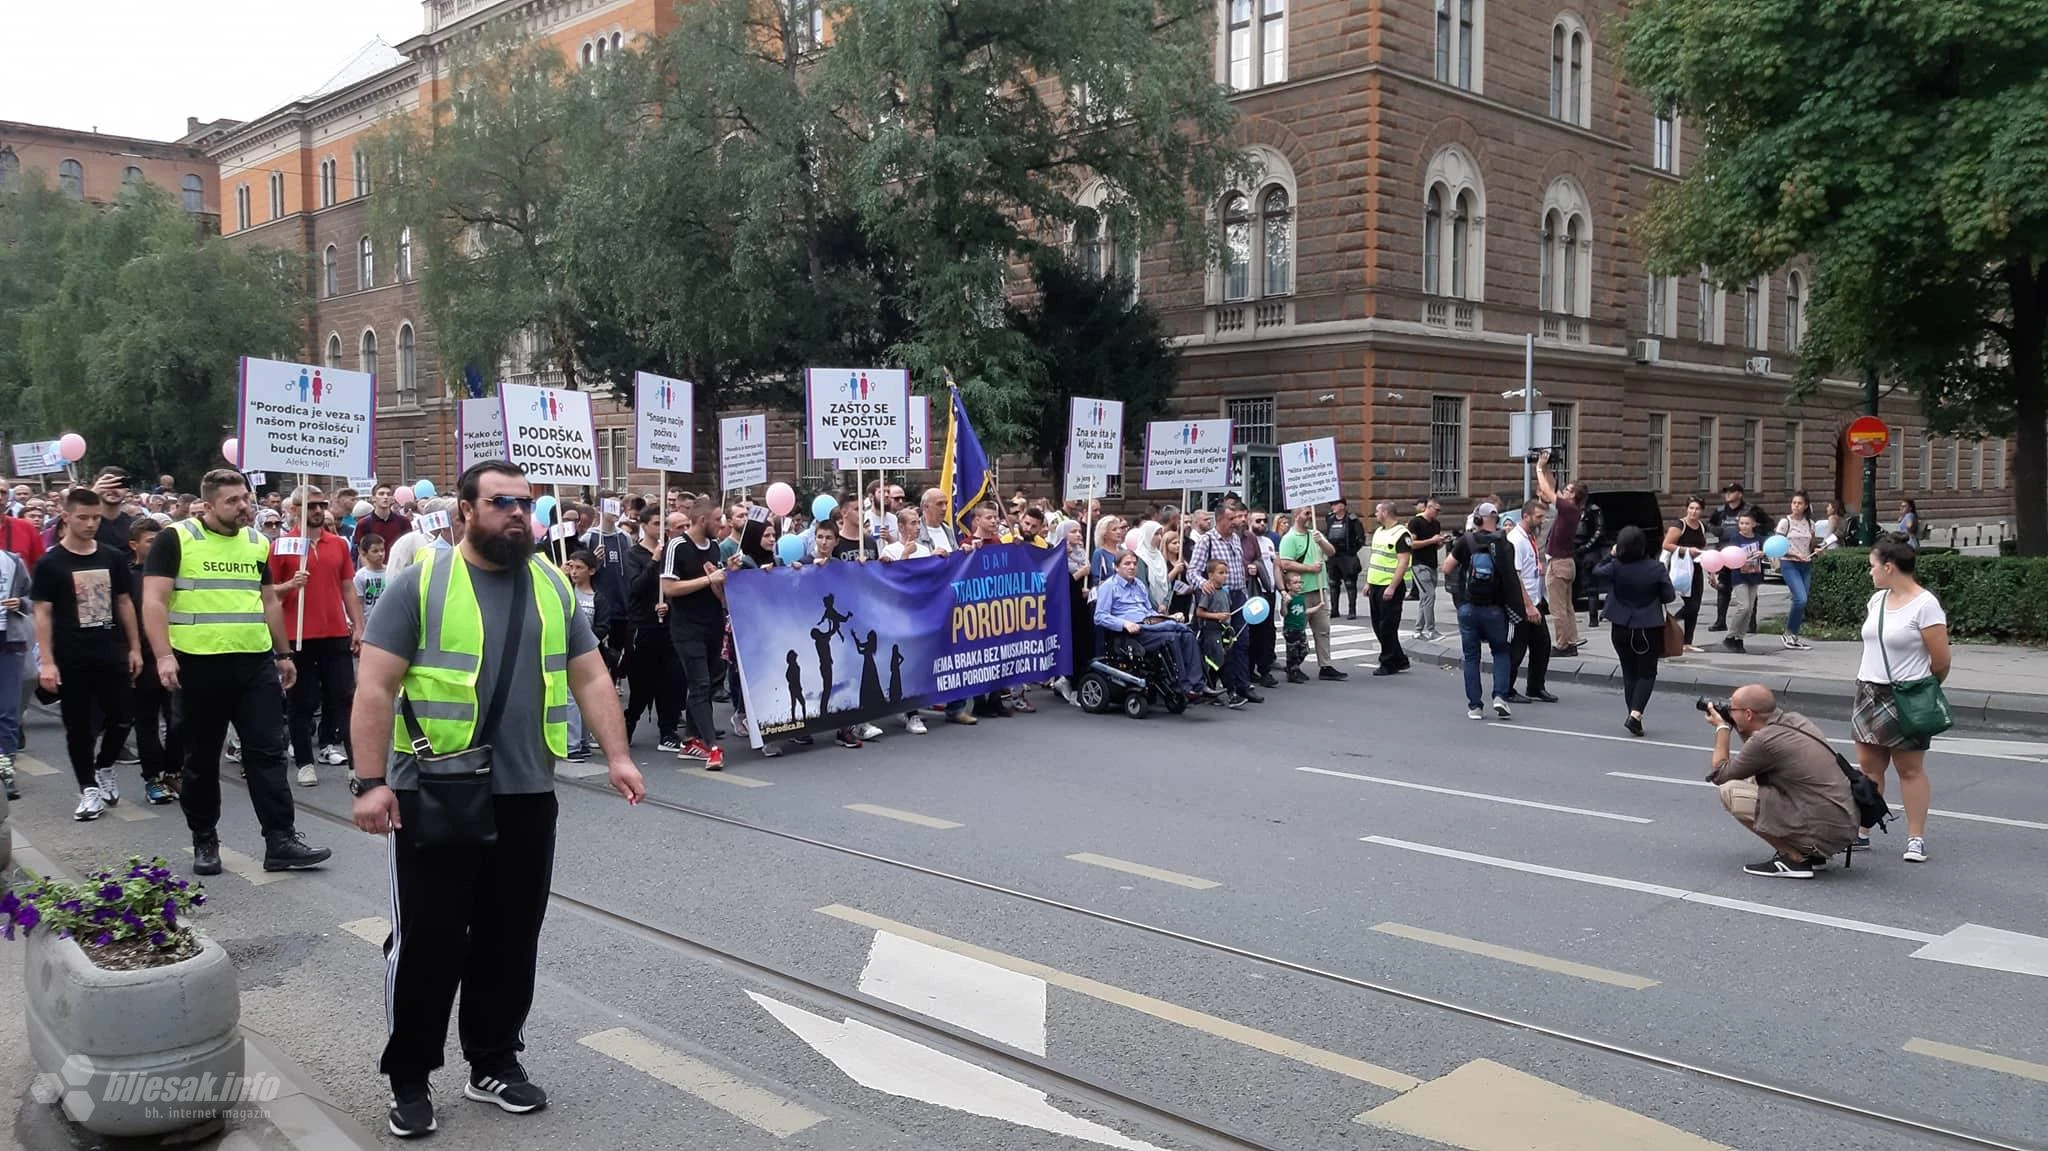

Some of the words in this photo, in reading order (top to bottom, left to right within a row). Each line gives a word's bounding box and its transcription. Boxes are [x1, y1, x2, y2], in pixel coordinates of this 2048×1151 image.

[311, 407, 323, 419] je
[326, 410, 351, 420] veza
[353, 414, 366, 422] sa
[830, 401, 870, 414] ZAŠTO
[874, 404, 888, 414] SE
[256, 416, 296, 428] našom
[299, 420, 354, 433] prošlošću
[822, 416, 839, 426] NE
[843, 414, 897, 426] POŠTUJE
[268, 431, 298, 441] most
[301, 433, 315, 443] ka
[318, 434, 349, 448] našoj
[519, 425, 584, 443] PODRŠKA
[840, 428, 880, 439] VOLJA
[1076, 427, 1089, 437] Zna
[1090, 430, 1098, 438] se
[1109, 429, 1117, 441] je
[512, 442, 593, 460] BIOLOŠKOM
[1085, 450, 1104, 460] brava
[286, 458, 309, 467] Aleks
[879, 456, 911, 464] DJECE
[520, 462, 590, 478] OPSTANKU
[203, 561, 257, 574] SECURITY
[983, 551, 1009, 570] DAN
[951, 571, 1046, 604] TRADICIONALNE
[952, 595, 1047, 644] PORODICE
[933, 656, 953, 676] NEMA
[954, 650, 982, 669] BRAKA
[983, 647, 999, 663] BEZ
[937, 672, 961, 693] NEMA
[962, 664, 1001, 687] PORODICE
[1001, 661, 1015, 678] BEZ
[1015, 657, 1031, 674] OCA
